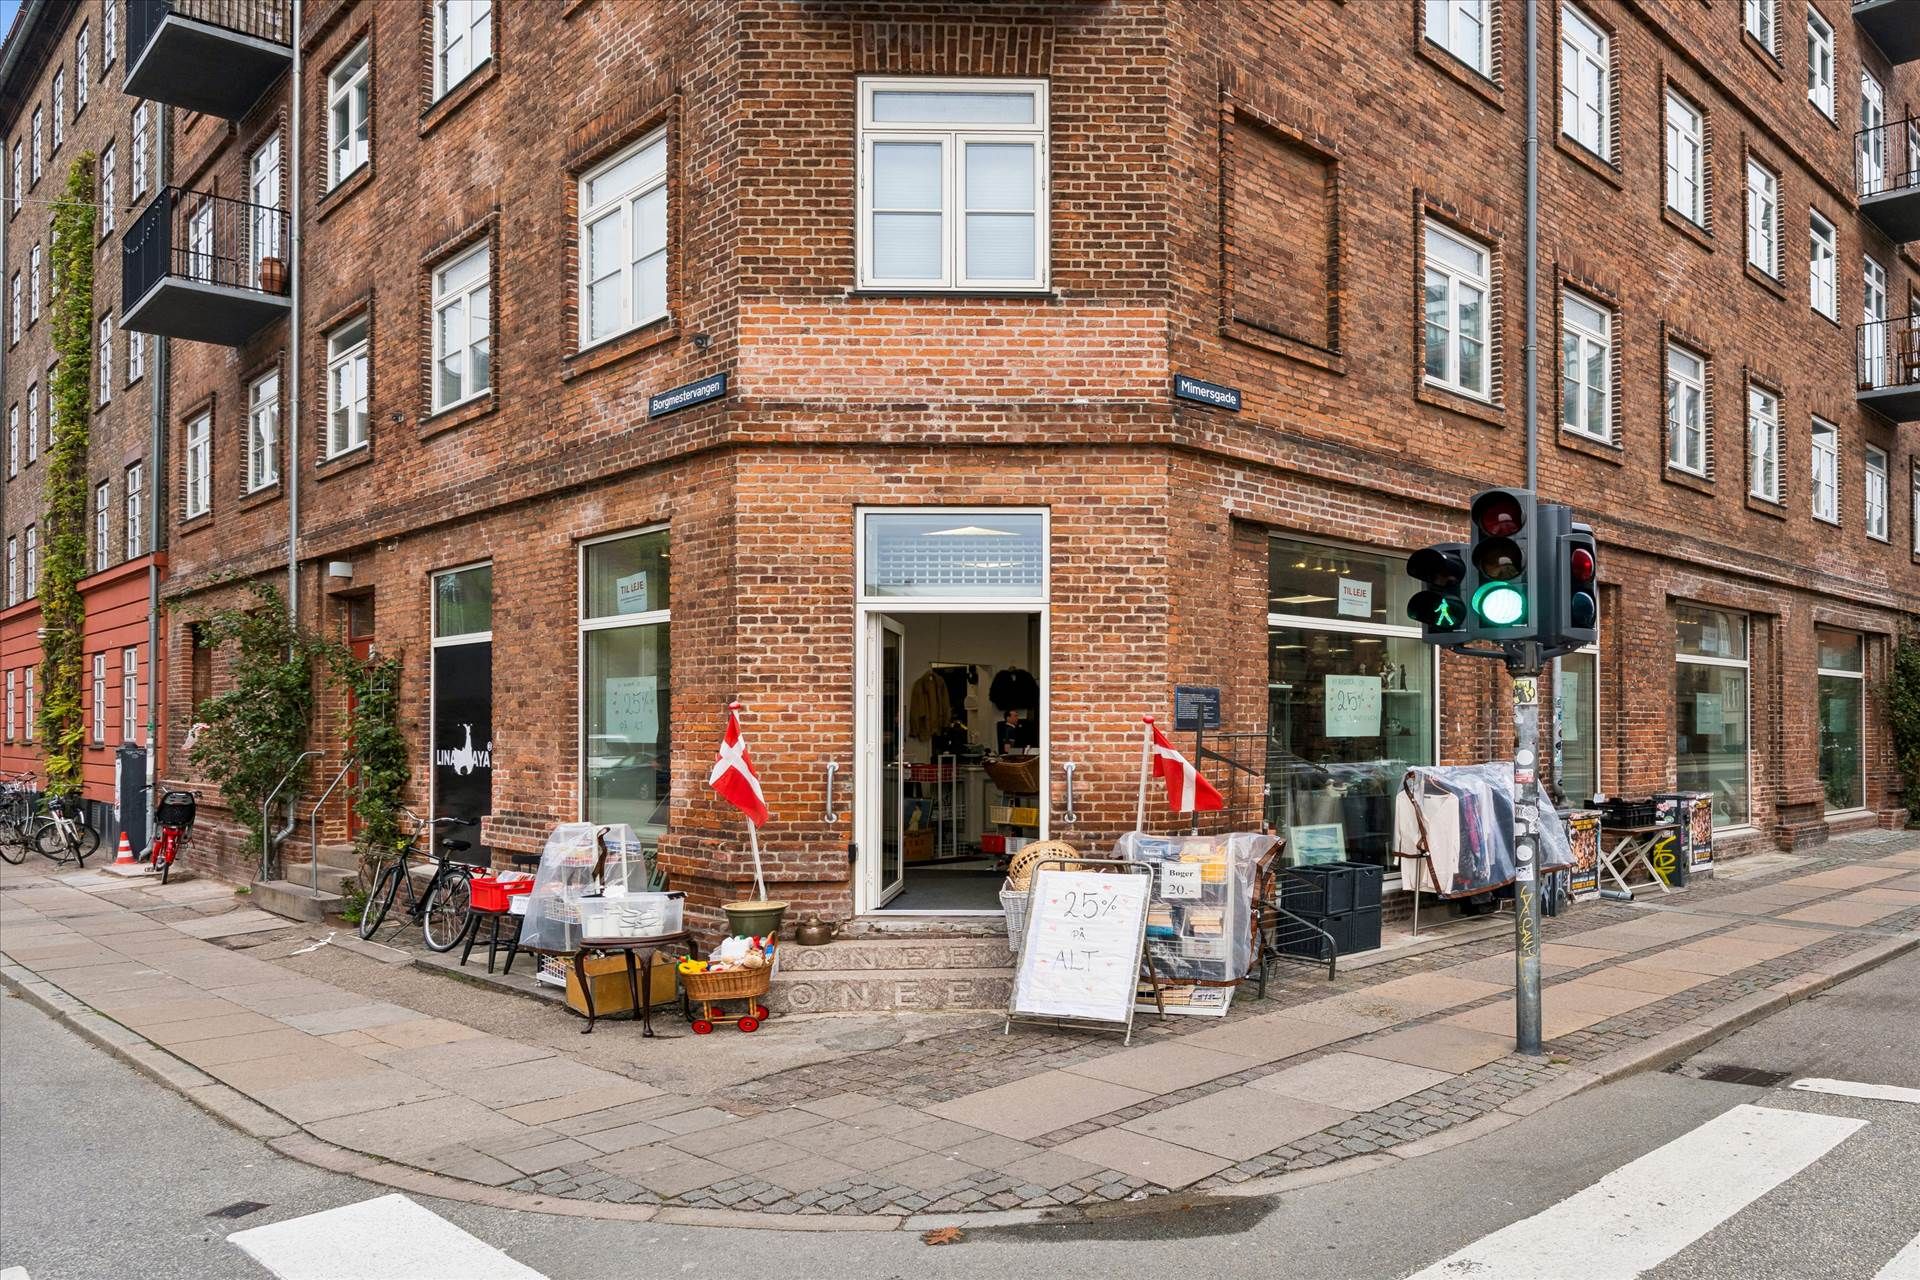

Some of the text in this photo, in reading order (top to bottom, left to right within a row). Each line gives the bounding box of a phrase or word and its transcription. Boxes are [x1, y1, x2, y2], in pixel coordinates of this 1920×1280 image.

[652, 381, 720, 411] Borgmestervangen
[1181, 379, 1237, 405] Mimersgade
[1343, 586, 1367, 598] TIL LEJE
[1337, 689, 1365, 711] 25%
[1063, 891, 1118, 919] 25%
[1072, 927, 1086, 941] PÅ
[1054, 949, 1100, 973] ALT
